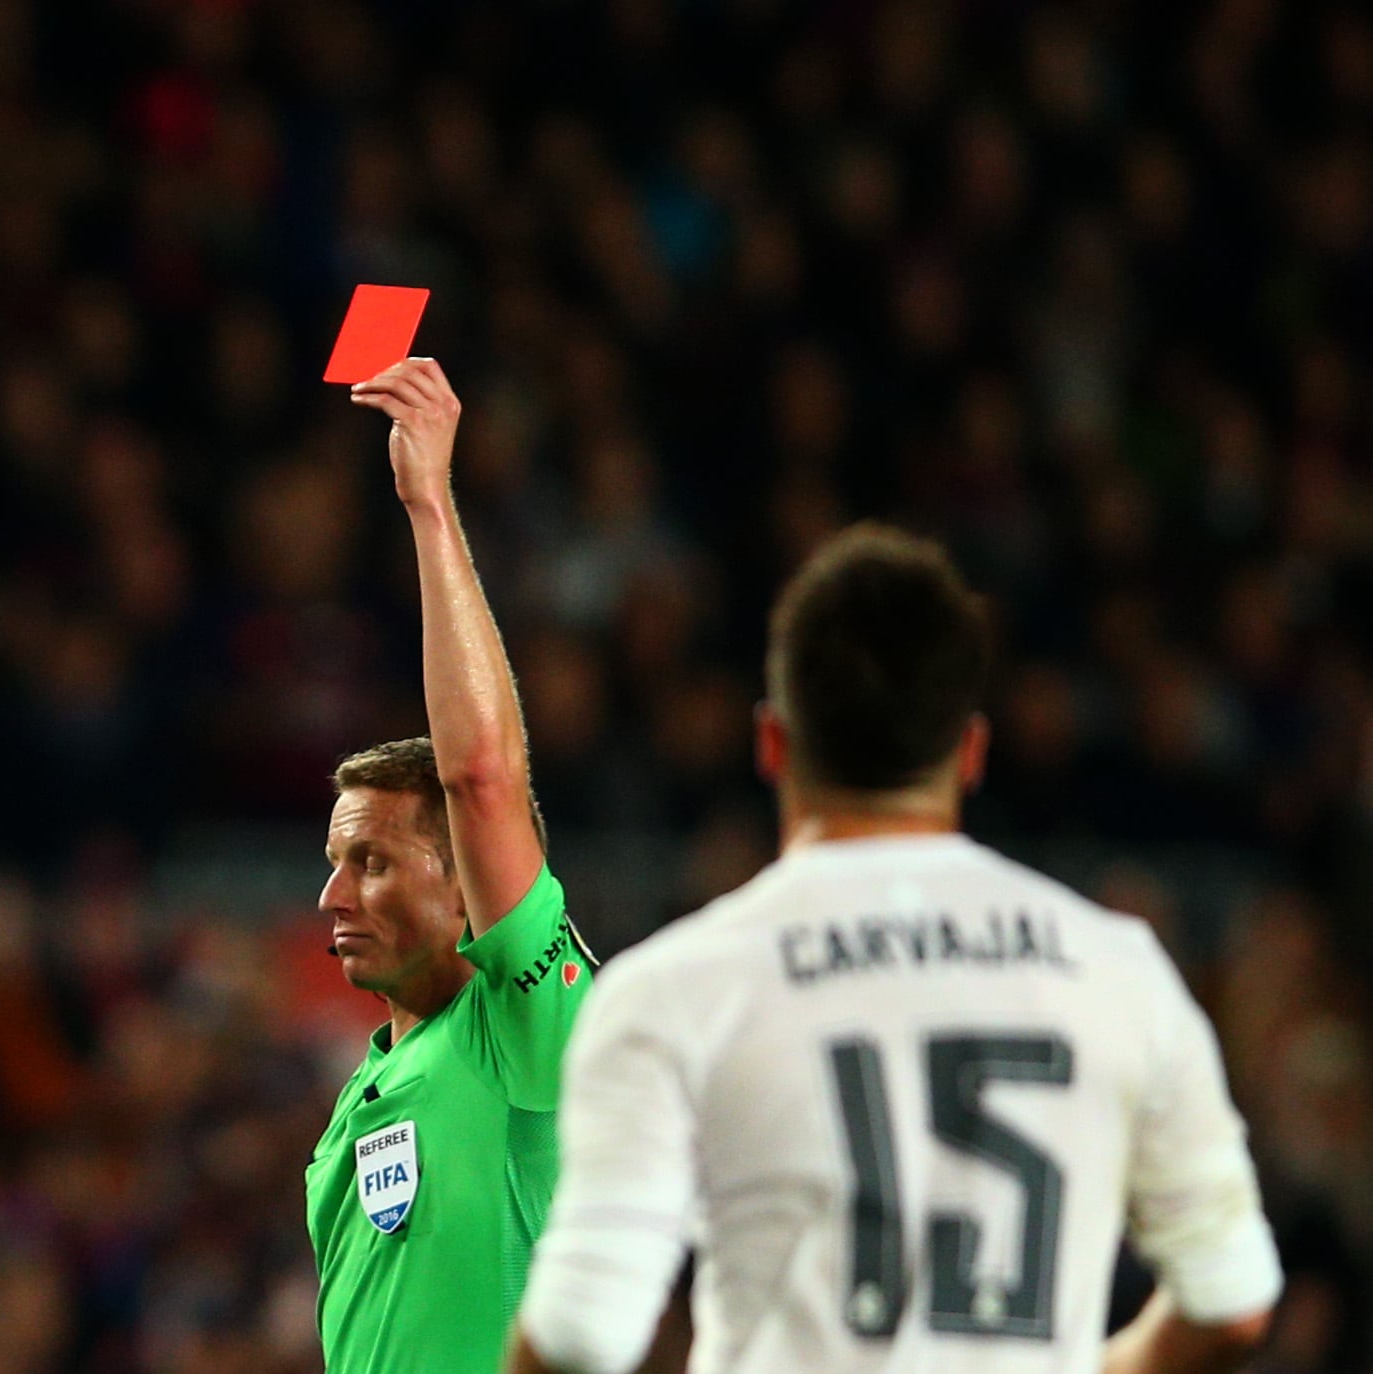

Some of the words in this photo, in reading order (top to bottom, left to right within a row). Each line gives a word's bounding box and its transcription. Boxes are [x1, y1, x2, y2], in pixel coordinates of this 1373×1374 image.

[782, 907, 1077, 986] CARVAJAL
[359, 1128, 409, 1159] REFEREE
[364, 1162, 408, 1196] FIFA
[828, 1032, 1073, 1337] 15
